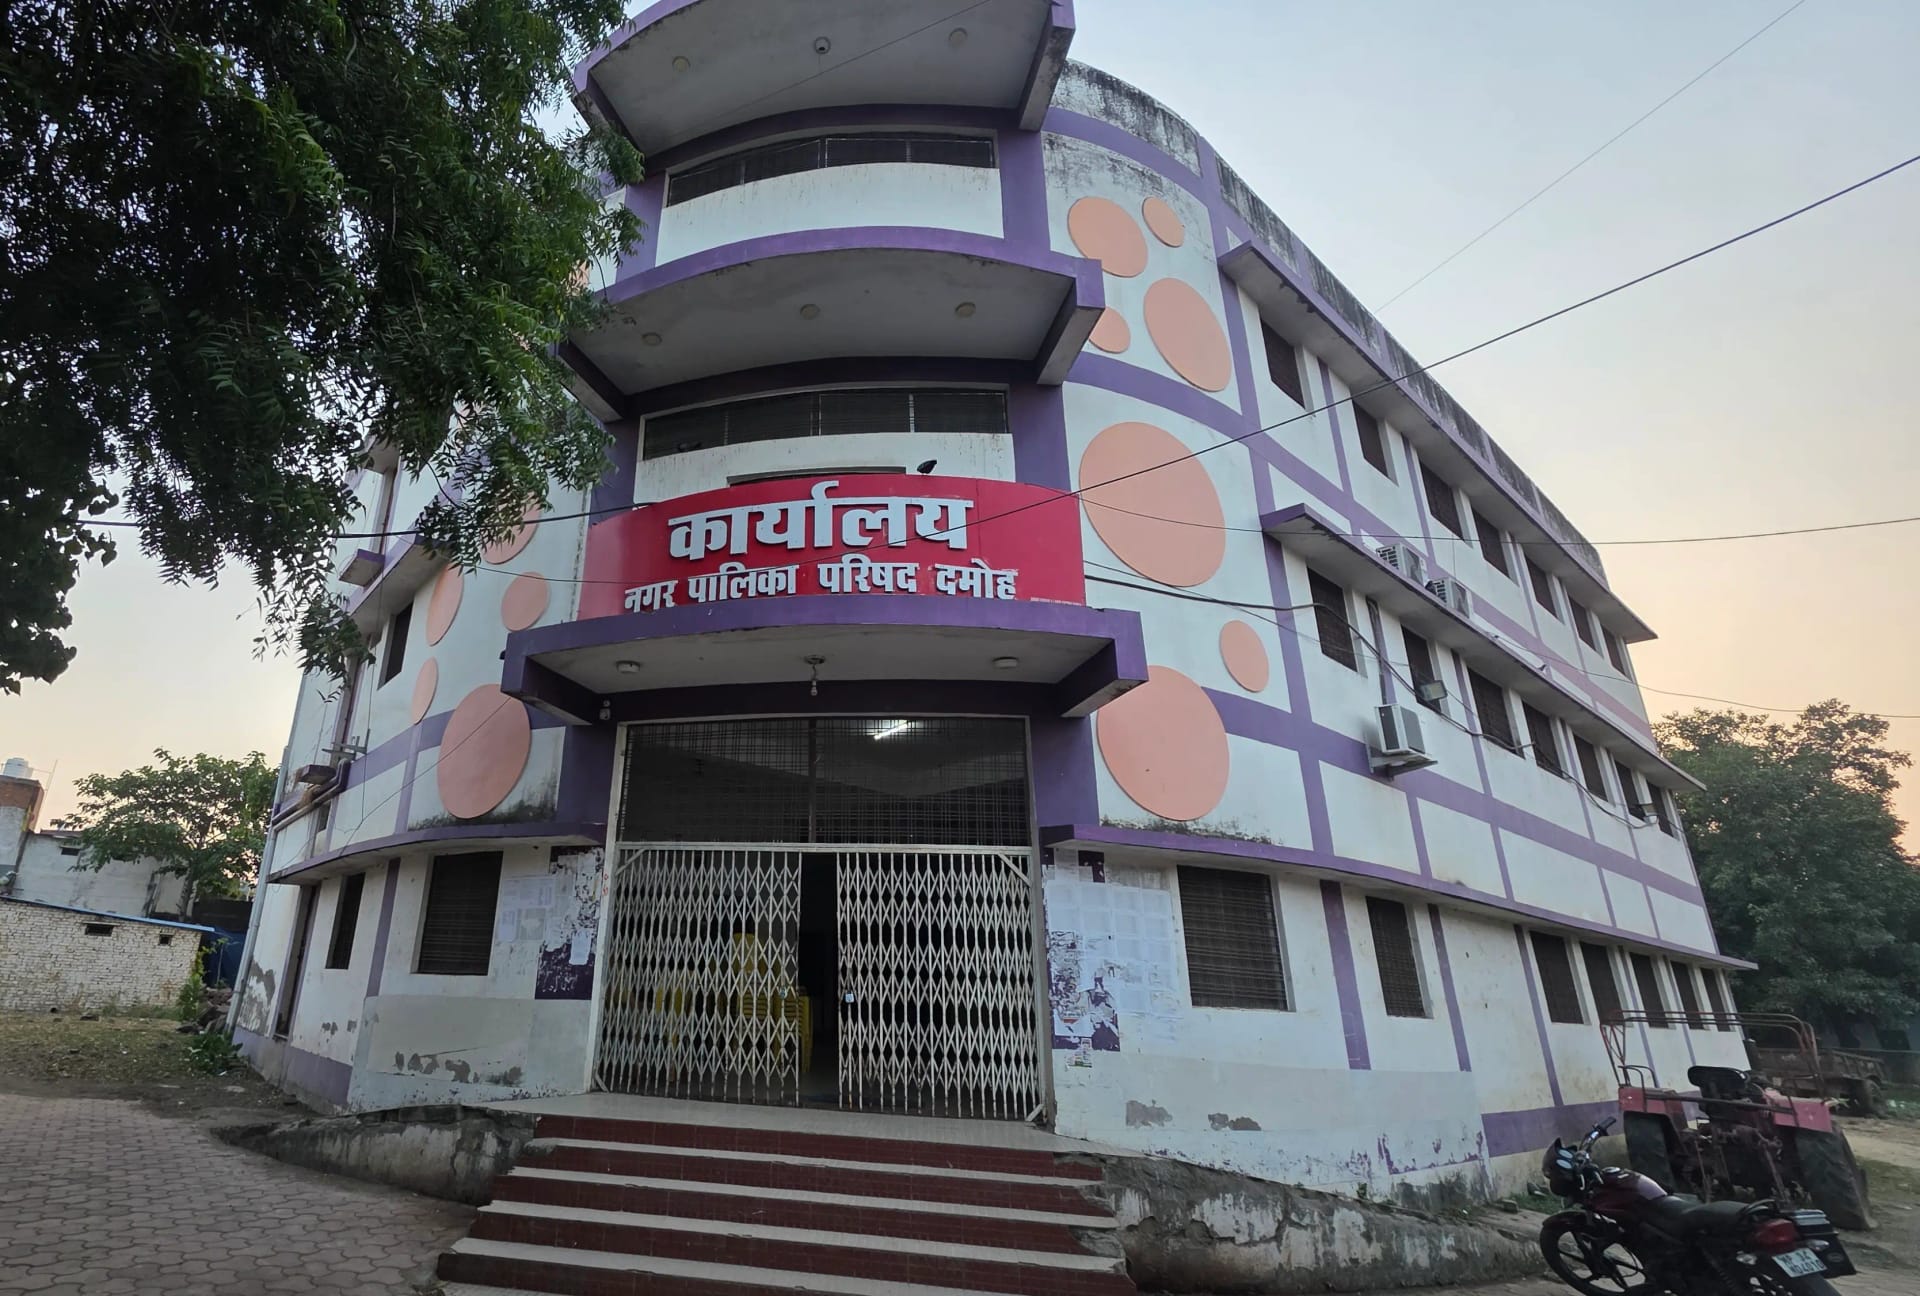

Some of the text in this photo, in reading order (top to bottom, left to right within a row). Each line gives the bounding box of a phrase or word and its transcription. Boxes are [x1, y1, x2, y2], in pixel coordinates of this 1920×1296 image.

[668, 480, 974, 559] कार्यालय
[624, 553, 1018, 612] नगर पालिका परिषद दमोह
